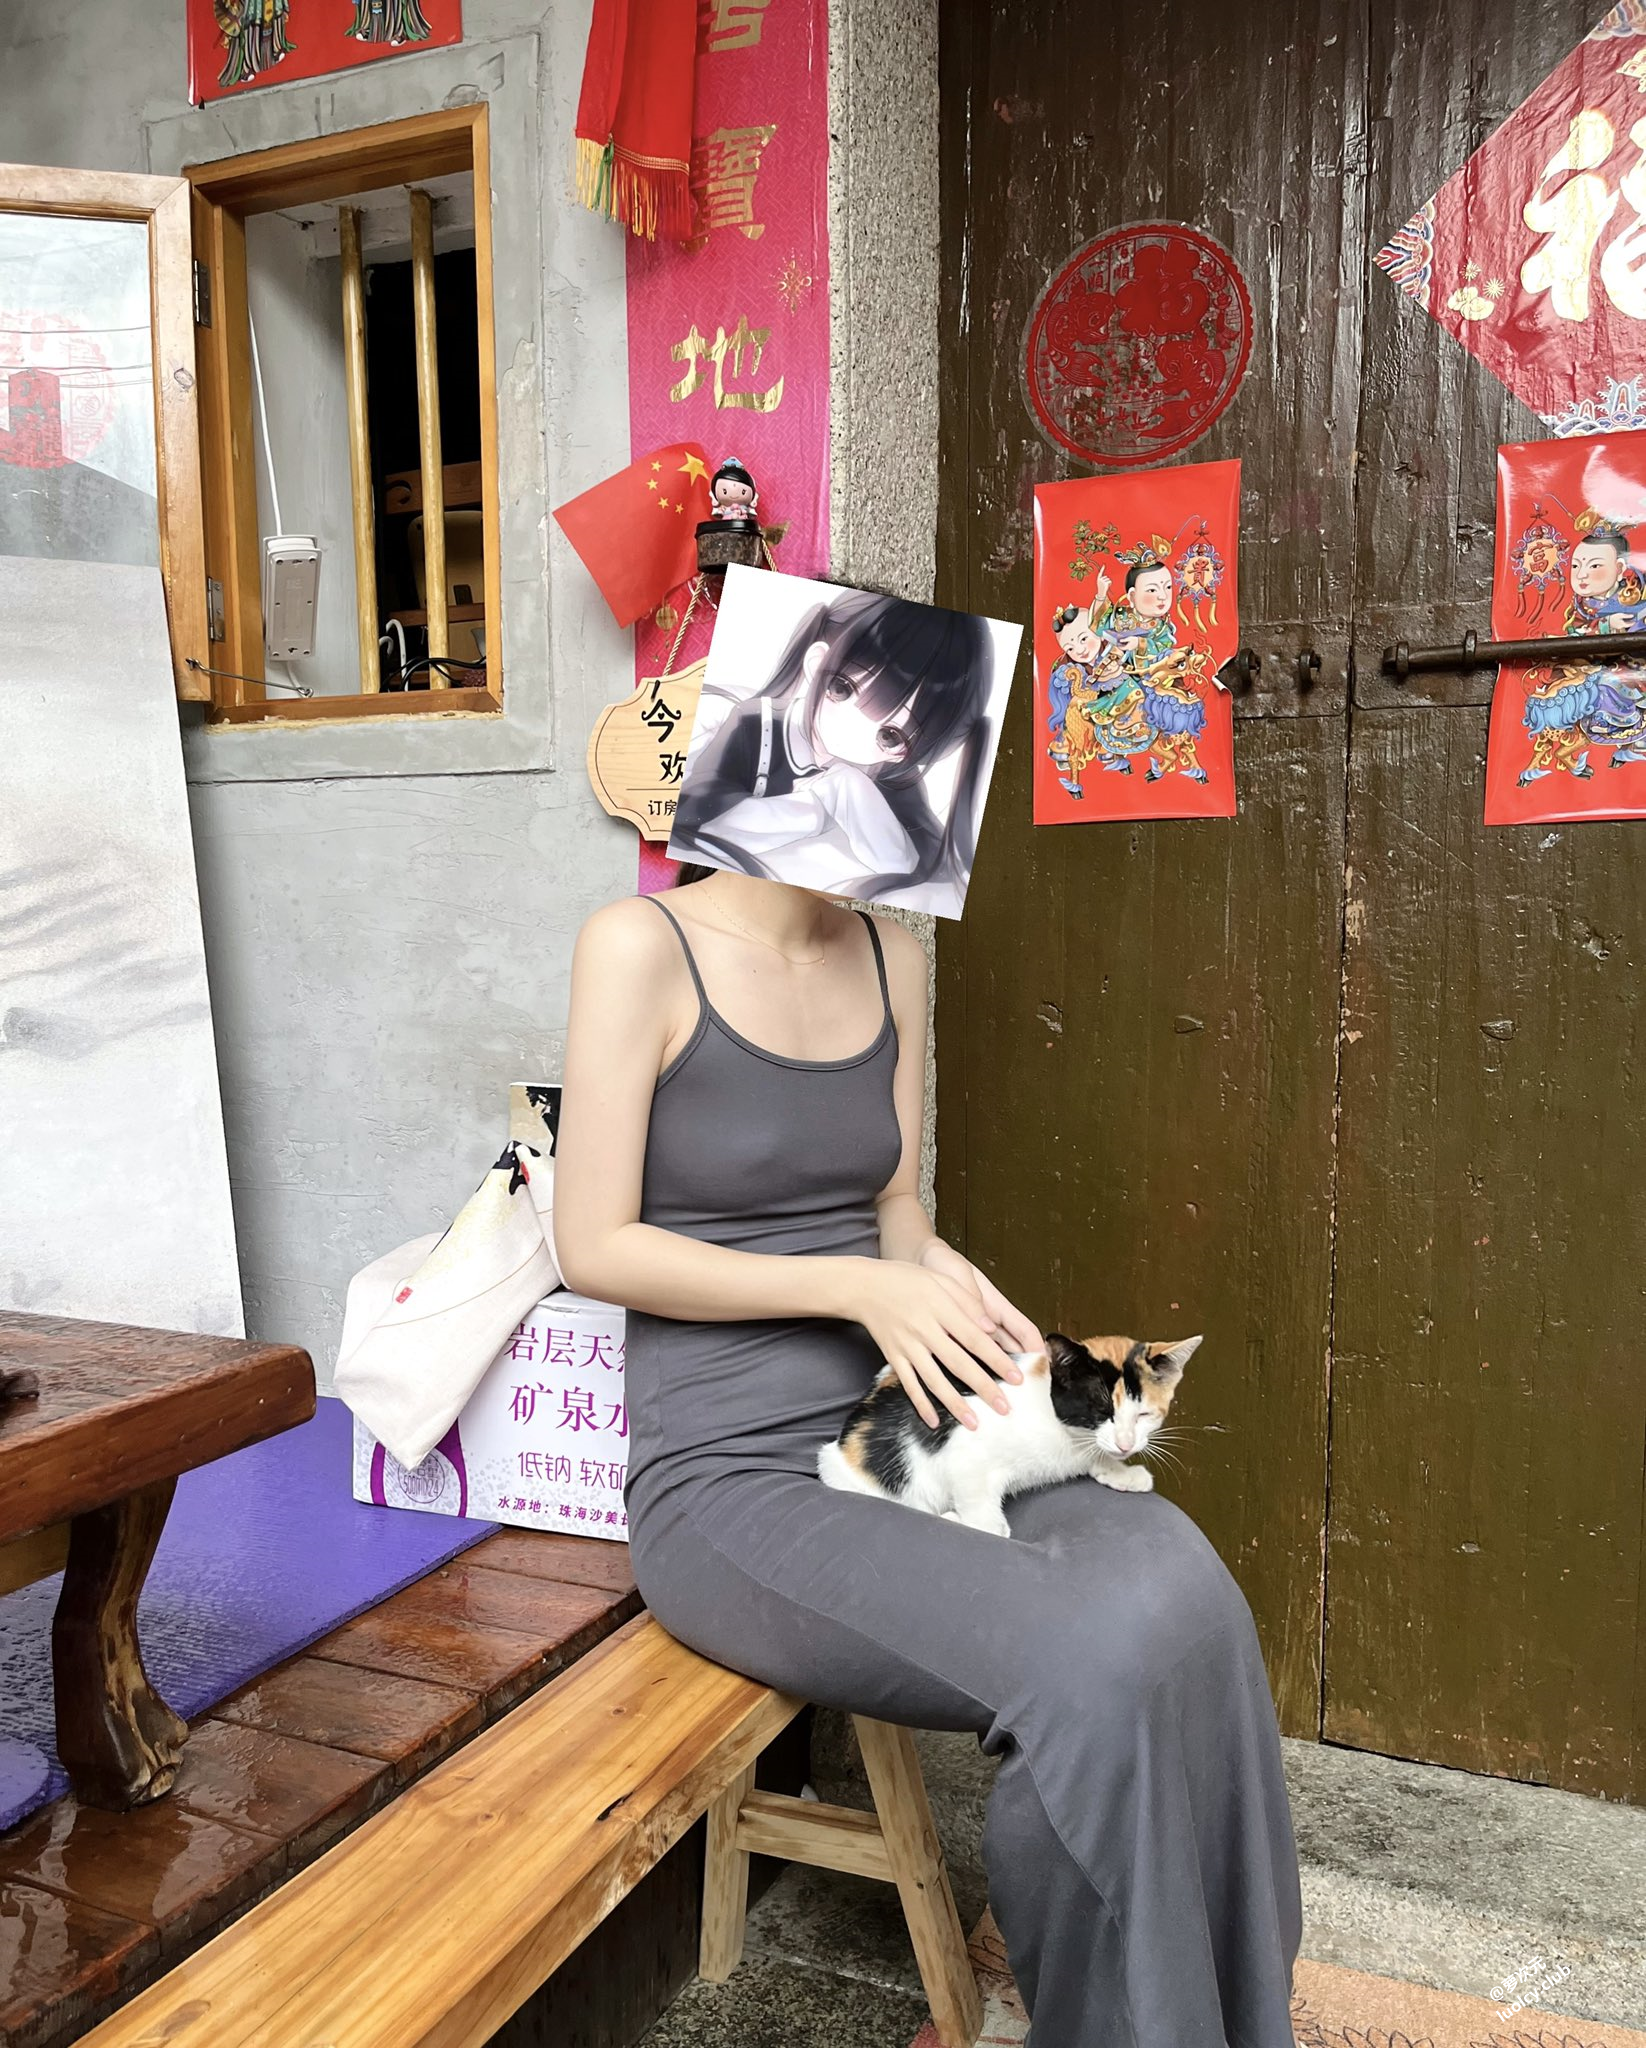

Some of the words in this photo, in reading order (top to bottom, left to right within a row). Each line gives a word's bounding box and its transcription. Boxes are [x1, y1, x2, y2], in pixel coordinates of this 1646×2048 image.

[1519, 110, 1646, 322] 福
[1527, 542, 1554, 573] 富
[641, 698, 682, 743] 今
[518, 1451, 571, 1484] 低钠
